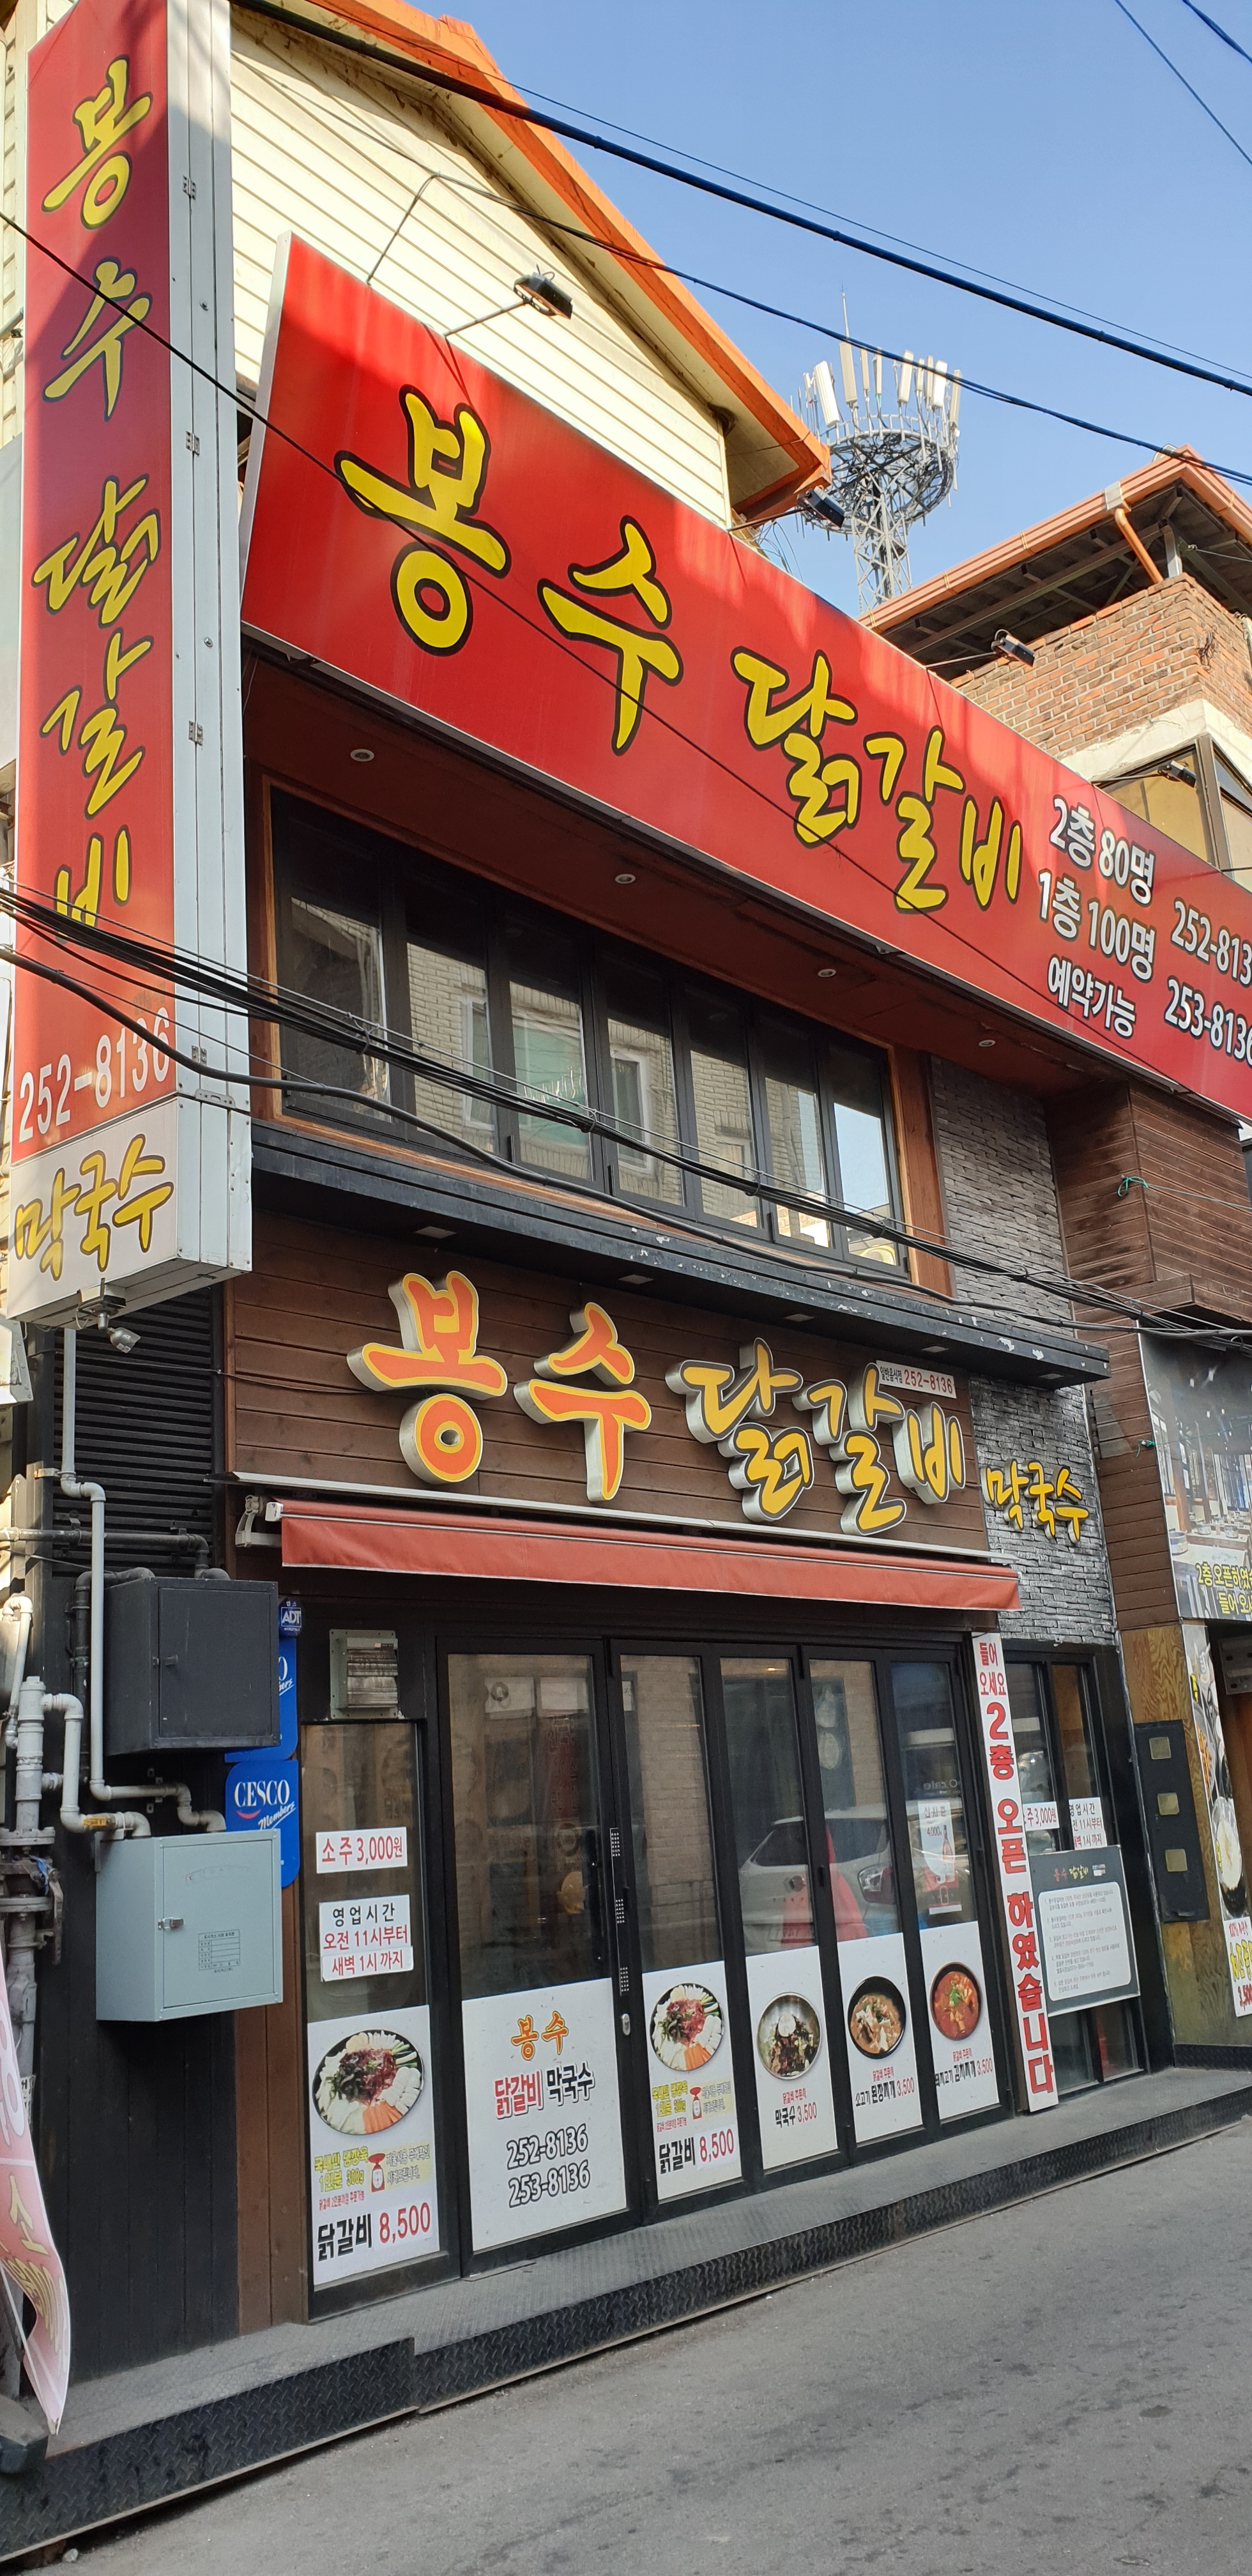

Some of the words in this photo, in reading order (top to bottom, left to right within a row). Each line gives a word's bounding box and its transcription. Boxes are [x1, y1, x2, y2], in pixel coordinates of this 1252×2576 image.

[731, 647, 1023, 914] 닭갈비
[1050, 795, 1096, 869] 2층
[1098, 829, 1156, 905] 80명
[1039, 869, 1081, 940] 1층
[1087, 900, 1156, 982] 100명
[1048, 956, 1136, 1039] 예약가능
[19, 1008, 171, 1144] 252-8136
[14, 1134, 174, 1280] 막국수
[903, 1368, 953, 1394] 252-8136
[665, 1337, 966, 1537] 닭갈비
[981, 1458, 1089, 1545] 막국수
[1195, 1561, 1213, 1587] 2층
[282, 1610, 302, 1625] ADT
[1218, 1591, 1240, 1616] 들어
[979, 1641, 998, 1667] 들어
[979, 1670, 1007, 1698] 오세요
[986, 1702, 1015, 1781] 2층
[234, 1779, 290, 1807] CESCO
[258, 1802, 296, 1831] Members
[322, 1837, 353, 1866] 소주
[356, 1835, 403, 1865] 3,000원
[997, 1798, 1027, 1874] 오픈
[323, 1930, 349, 1951] 오전
[355, 1924, 408, 1947] 11시부터
[333, 1903, 395, 1928] 영업시간
[332, 1955, 355, 1976] 새벽
[1006, 1891, 1054, 2095] 하였습니다
[511, 2010, 569, 2061] 봉수
[977, 2057, 993, 2076] 3,500
[494, 2070, 542, 2119] 닭갈비
[546, 2062, 595, 2106] 막국수
[855, 2090, 871, 2107] 소고기
[871, 2080, 896, 2104] 된장찌개
[896, 2076, 915, 2097] 3,500
[775, 2106, 796, 2129] 막국수
[797, 2101, 818, 2124] 3,500
[507, 2123, 588, 2170] 252-8136
[659, 2136, 695, 2175] 닭갈비
[699, 2128, 735, 2163] 8,500
[346, 2168, 365, 2187] 300g
[508, 2160, 590, 2208] 253-8136
[317, 2213, 372, 2262] 닭갈비
[379, 2202, 431, 2244] 8,500
